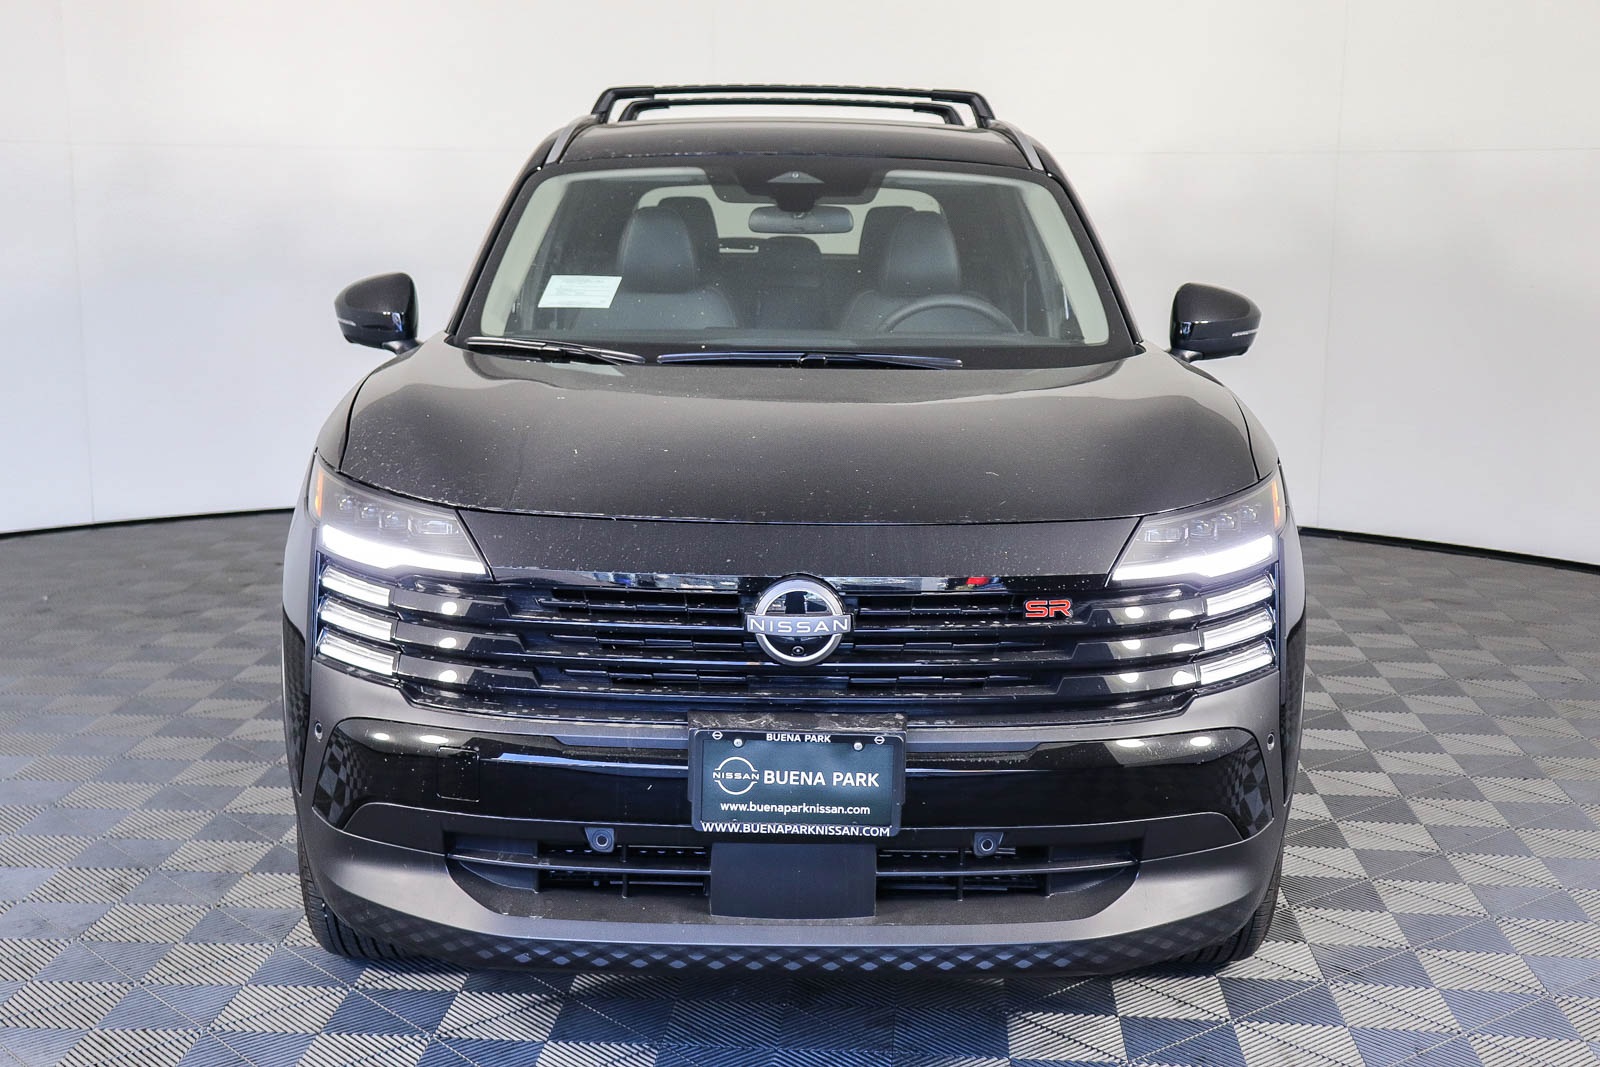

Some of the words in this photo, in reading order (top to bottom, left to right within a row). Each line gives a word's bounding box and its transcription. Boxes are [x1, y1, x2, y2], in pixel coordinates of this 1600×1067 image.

[1025, 599, 1072, 618] SR
[750, 617, 849, 634] NISSAN
[766, 733, 801, 742] BUENA
[804, 734, 831, 743] PARK
[713, 771, 759, 780] NISSAN
[763, 769, 826, 786] BUENA
[832, 772, 879, 787] PARK
[720, 801, 871, 815] www.buenaparknissan.com
[701, 822, 890, 837] WWW.BUENAPARKNISSAN.COM
